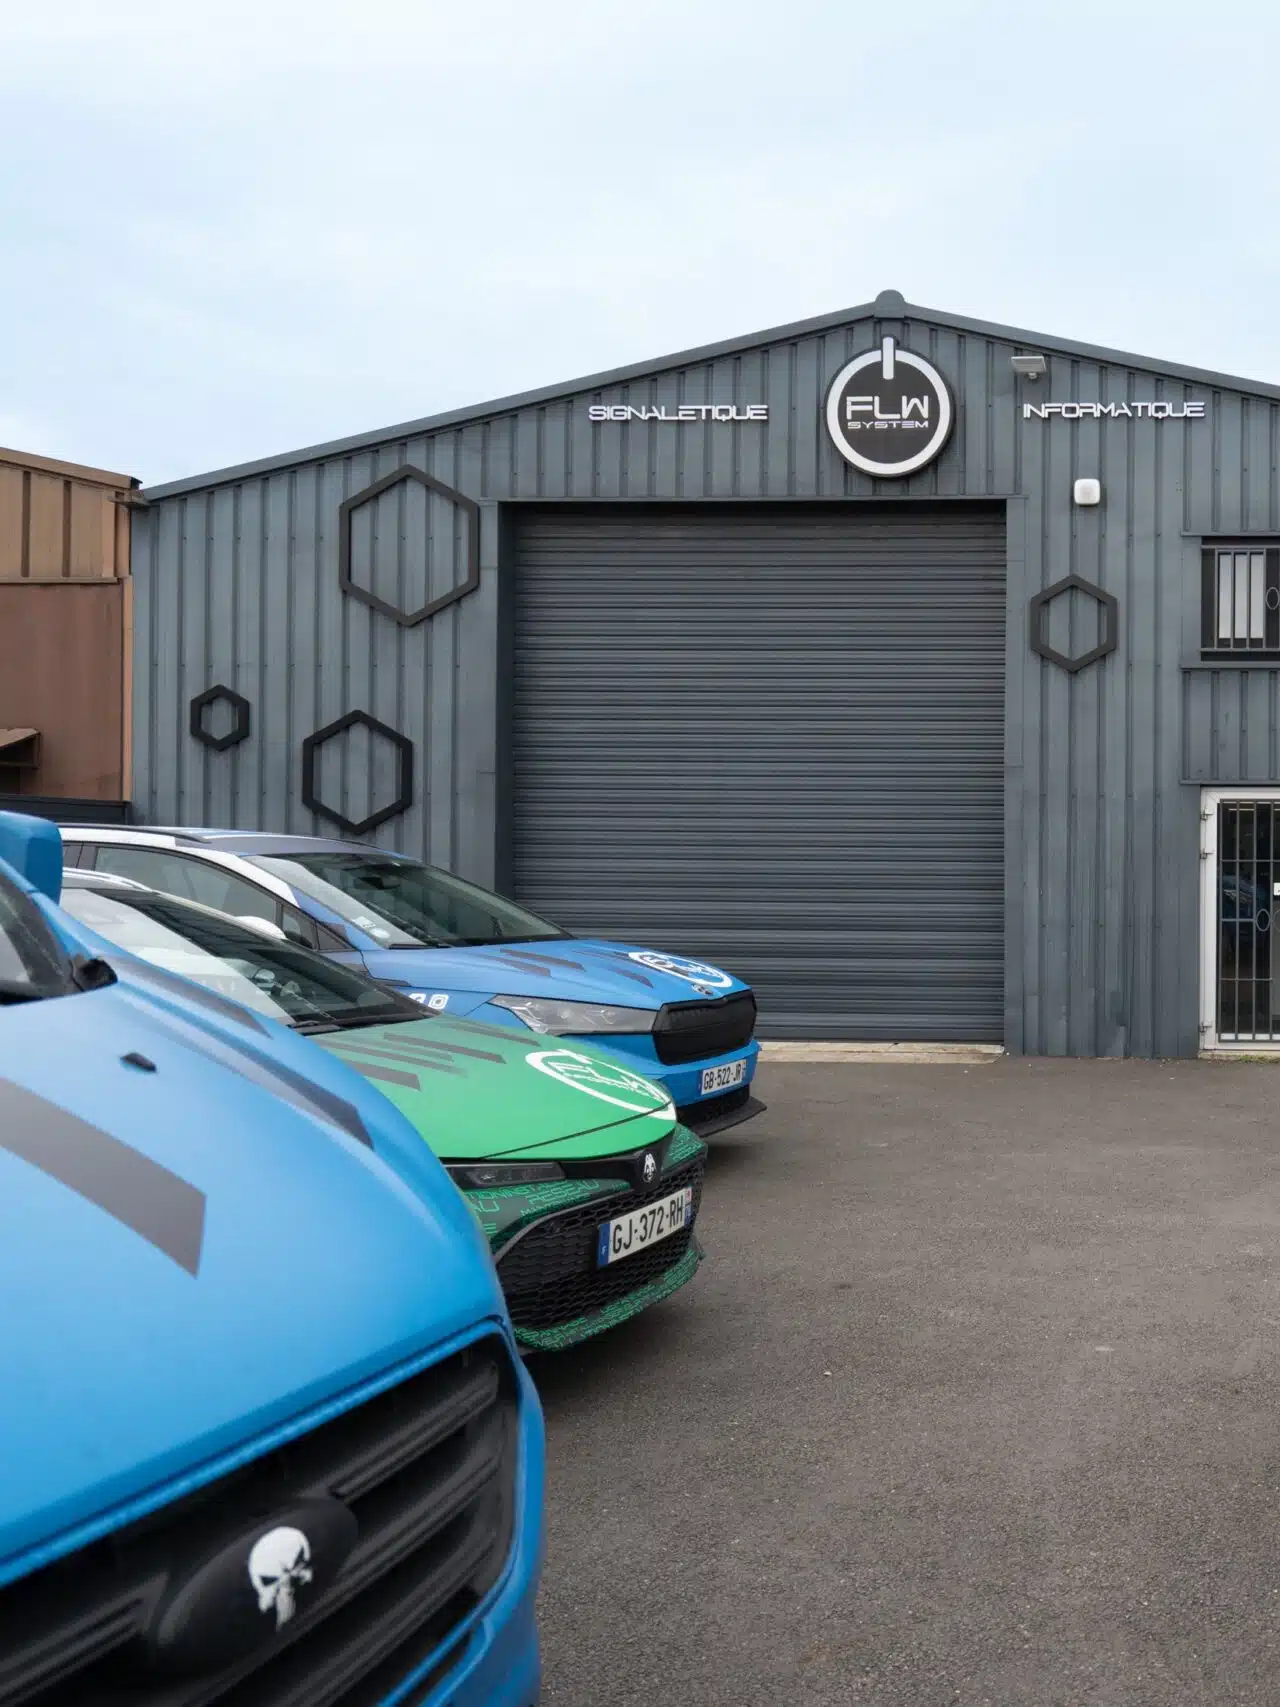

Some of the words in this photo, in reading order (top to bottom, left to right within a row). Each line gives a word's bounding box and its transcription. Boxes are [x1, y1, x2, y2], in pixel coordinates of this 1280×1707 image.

[589, 405, 767, 421] SIGNALETIQUE
[846, 395, 929, 420] FLW
[1024, 402, 1204, 418] INFORMATIQUE
[847, 420, 929, 429] SYSTEM
[703, 1063, 741, 1091] GB-522-JR
[612, 1195, 684, 1254] GJ-372-RH
